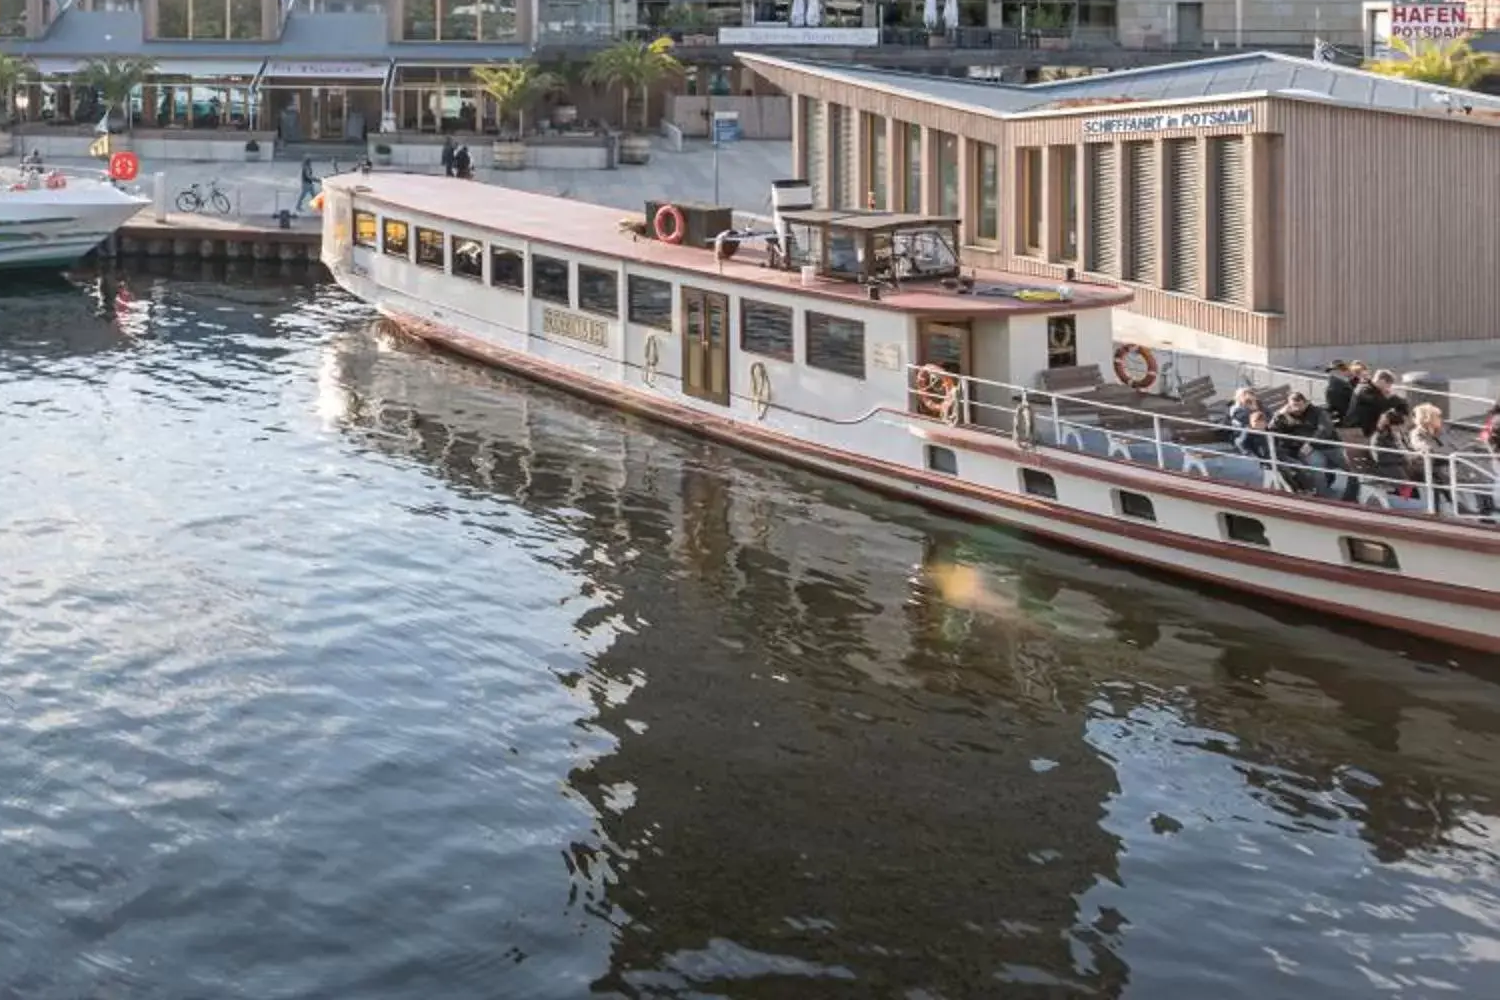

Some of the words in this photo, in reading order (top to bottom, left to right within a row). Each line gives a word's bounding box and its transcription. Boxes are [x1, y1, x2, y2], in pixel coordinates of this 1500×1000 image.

[1393, 6, 1465, 22] HAFEN
[1084, 115, 1162, 133] SCHIFFFAHRT
[1167, 117, 1179, 127] in
[1182, 109, 1249, 126] POTSDAM
